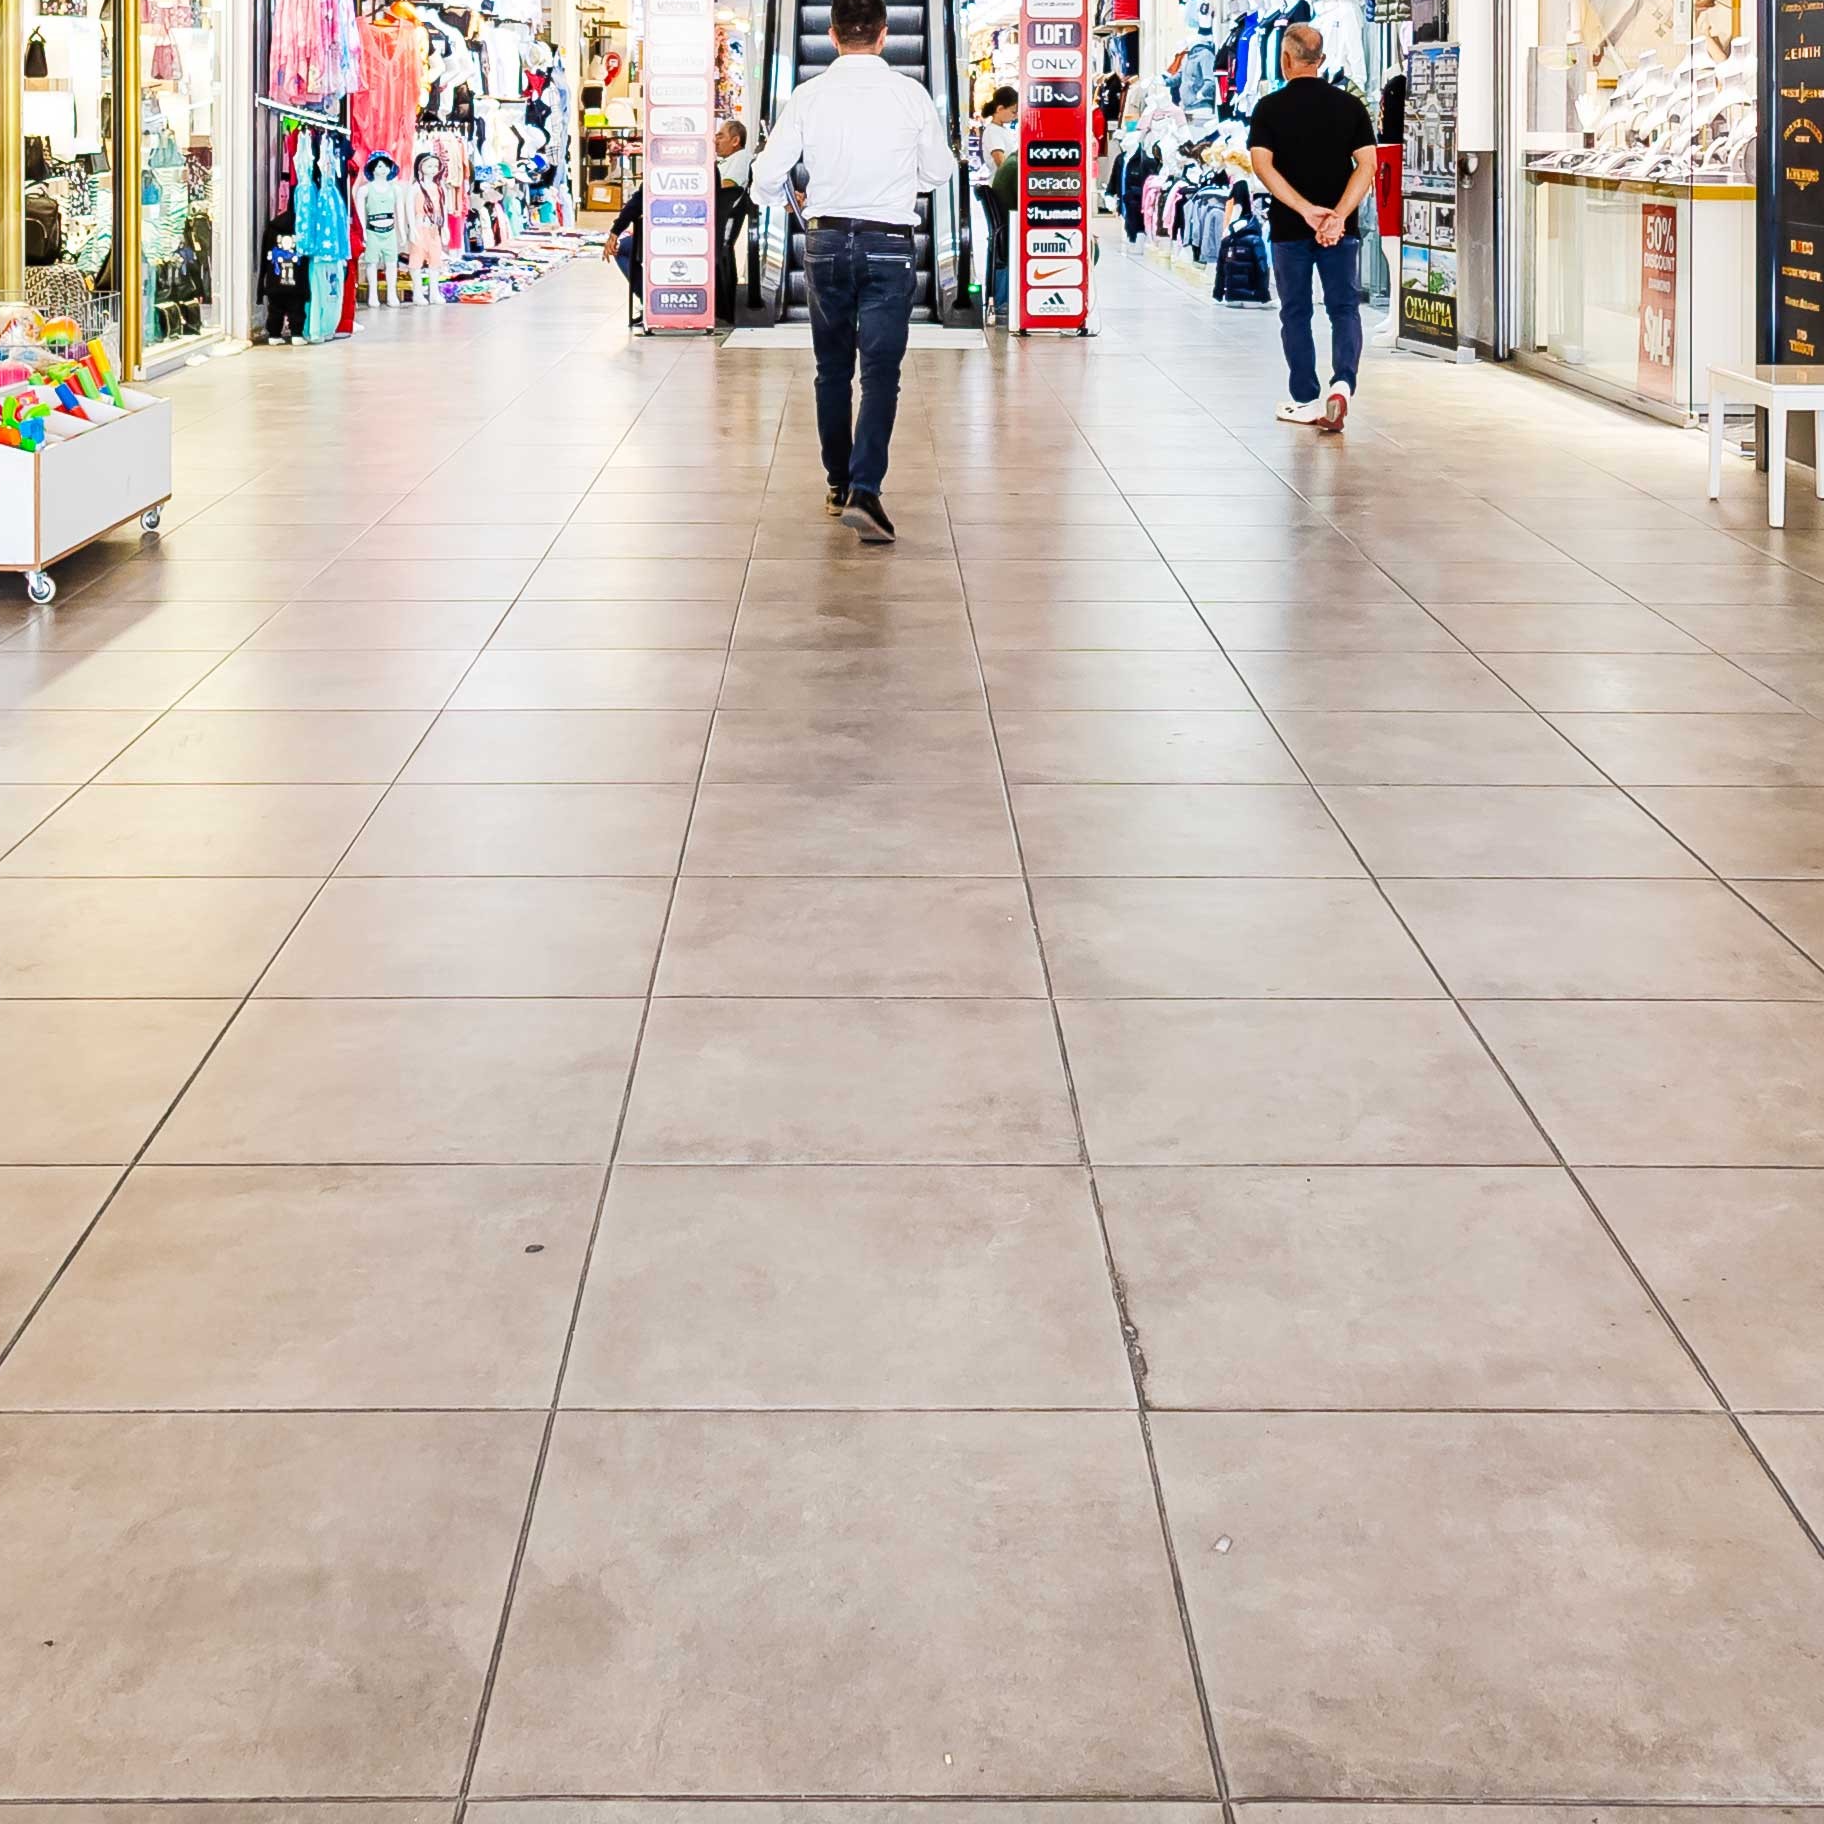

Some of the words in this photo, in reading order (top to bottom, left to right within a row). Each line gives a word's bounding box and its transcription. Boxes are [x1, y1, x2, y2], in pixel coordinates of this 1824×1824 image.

[1035, 24, 1073, 44] LOFT
[1032, 59, 1077, 69] ONLY
[1029, 86, 1053, 102] LTB
[657, 173, 699, 190] VANS
[1029, 178, 1080, 190] DeFacto
[1035, 207, 1081, 220] hummel
[665, 235, 693, 244] BOSS
[1646, 213, 1675, 254] 50%
[1033, 243, 1066, 253] PUMA
[1644, 252, 1676, 273] DISCOUNT
[660, 294, 697, 303] BRAX
[1039, 304, 1070, 313] adidas
[1404, 295, 1454, 330] OLYMPIA
